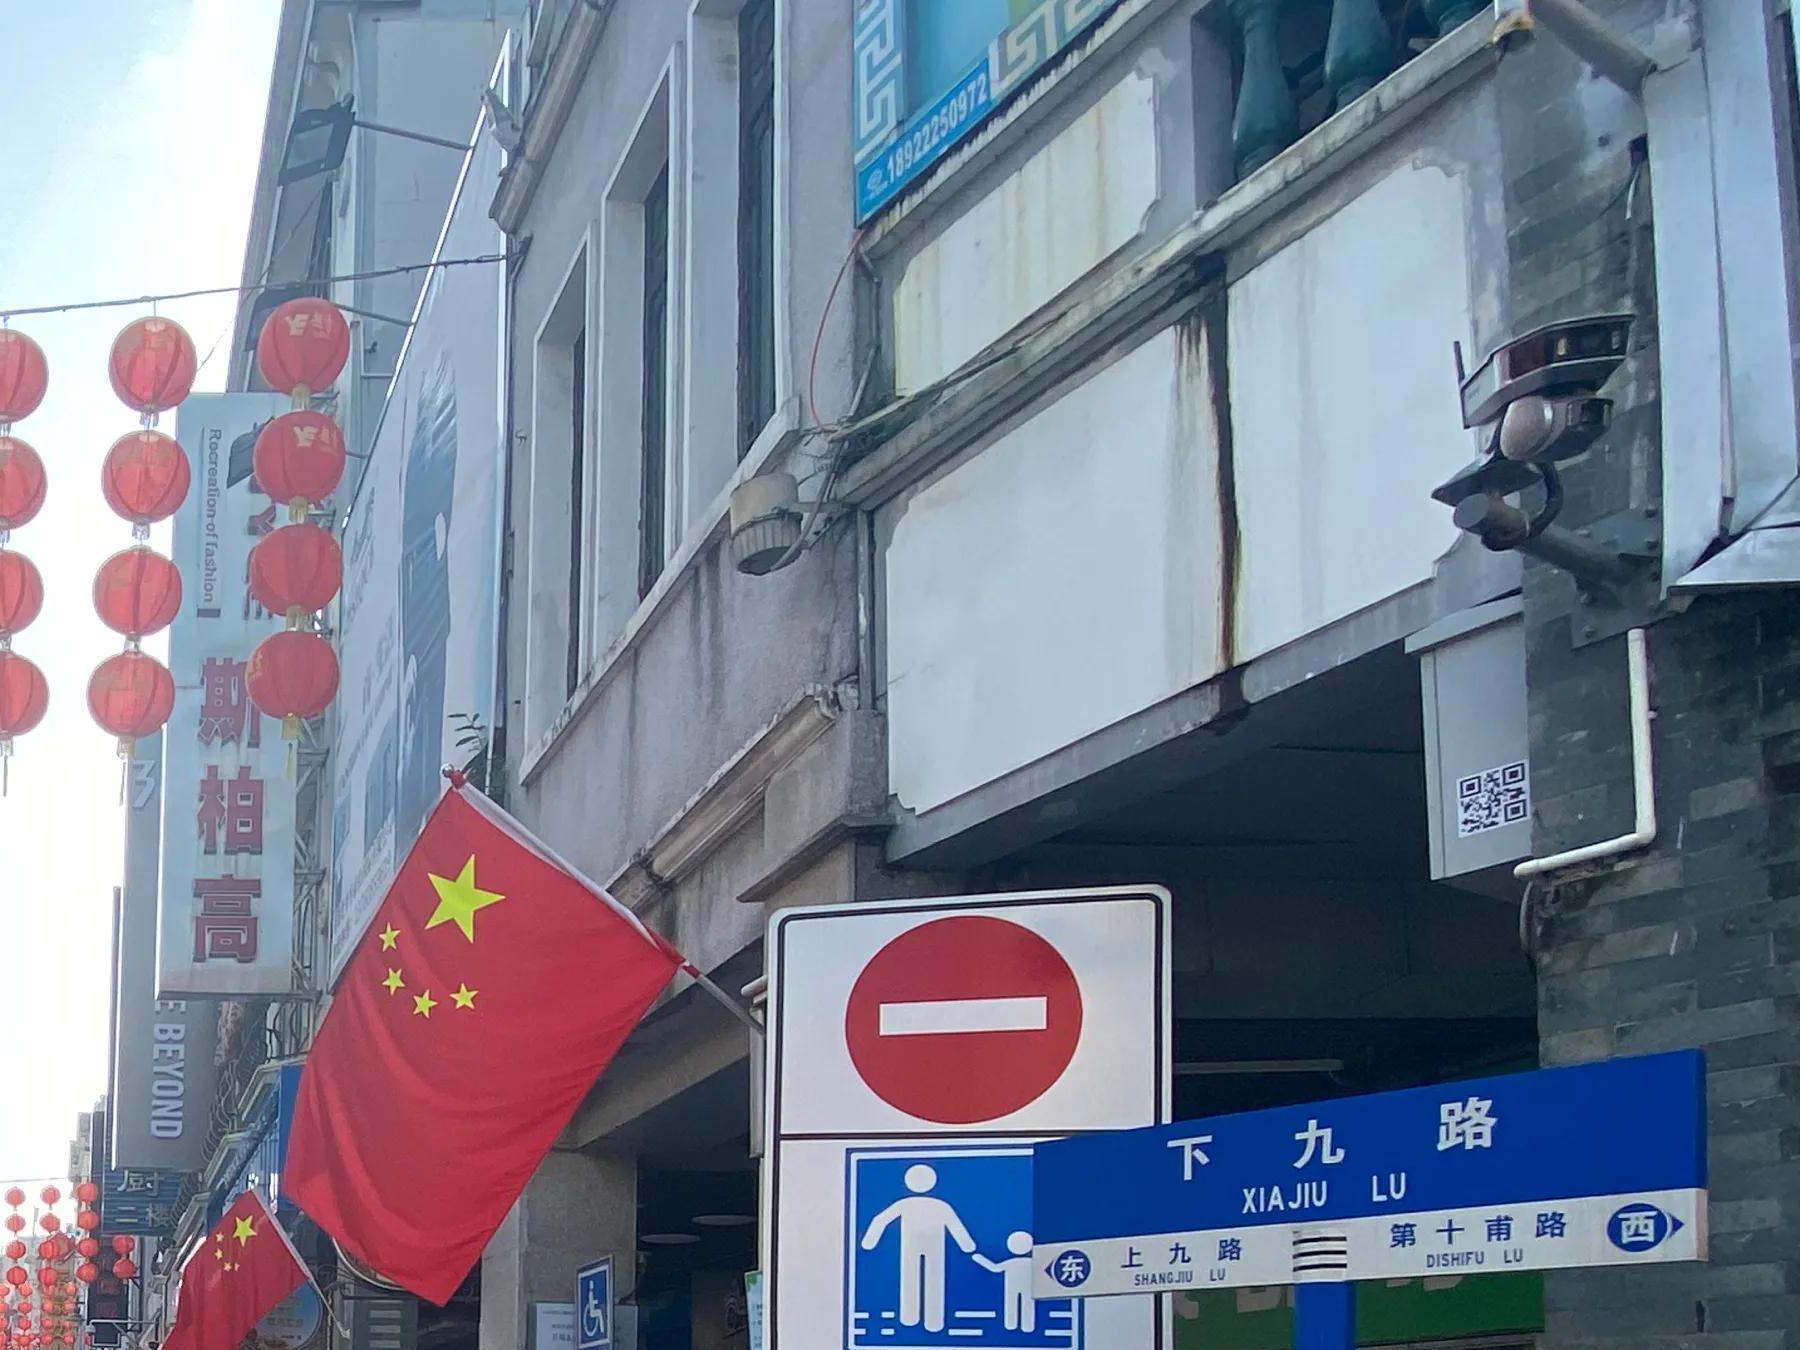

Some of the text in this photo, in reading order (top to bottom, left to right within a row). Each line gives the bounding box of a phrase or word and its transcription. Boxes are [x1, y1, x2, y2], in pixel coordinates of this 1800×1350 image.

[885, 72, 988, 186] 18922250972
[202, 541, 219, 604] fashion
[150, 1022, 186, 1140] BEYOND
[1166, 1096, 1498, 1182] 下九路
[117, 1169, 166, 1198] 厨
[1241, 1172, 1407, 1215] XIAJIU LU
[114, 1202, 171, 1229] 二楼
[1389, 1211, 1568, 1250] 第十甫路
[1616, 1210, 1657, 1245] 西
[1058, 1255, 1086, 1283] 东
[1119, 1237, 1243, 1271] 上九路
[1425, 1247, 1524, 1269] DISHIFU LU
[1133, 1268, 1226, 1287] SHANGJIU LU
